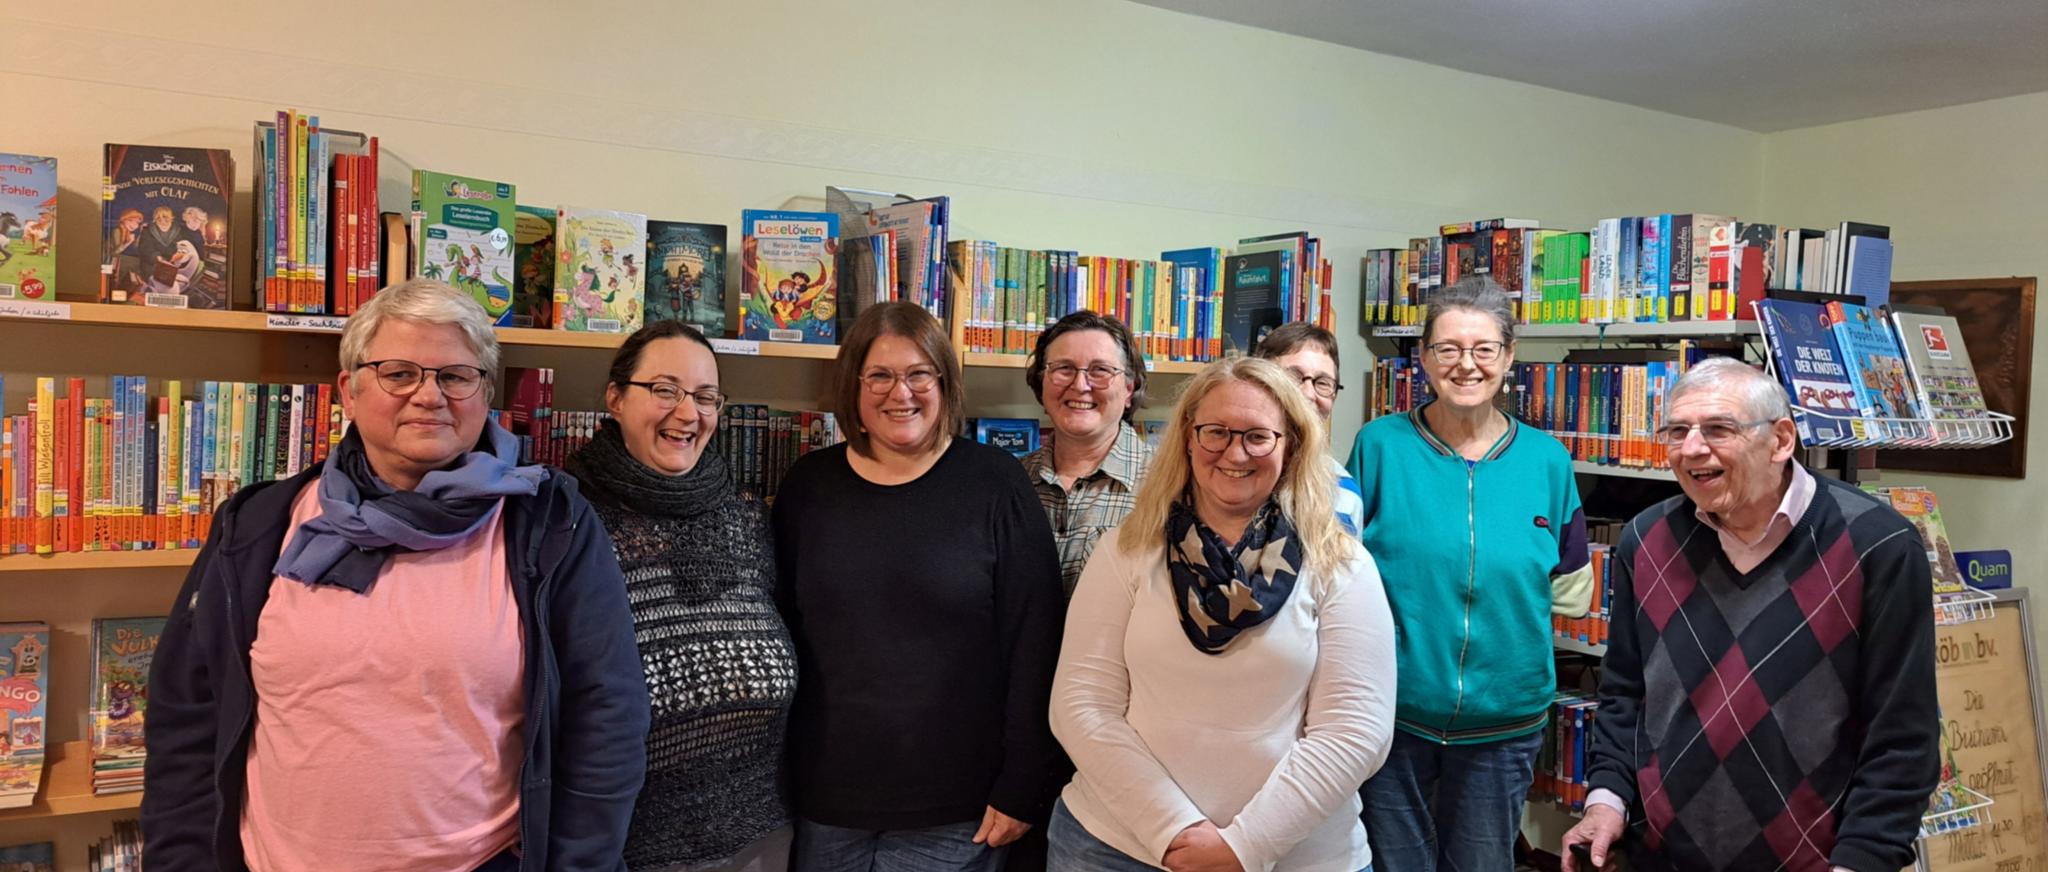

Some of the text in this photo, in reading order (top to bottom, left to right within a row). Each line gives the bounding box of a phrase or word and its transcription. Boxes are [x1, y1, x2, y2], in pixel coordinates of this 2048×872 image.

[143, 161, 194, 173] EISKÖNIGIN
[1, 184, 39, 197] Fohlen
[758, 223, 823, 236] Leselöwen
[308, 319, 344, 329] Sachbü
[1796, 346, 1833, 361] DIE WELT
[1795, 359, 1844, 376] DER KNOTEN
[992, 436, 1024, 448] Major Tom
[38, 472, 50, 485] Till
[1968, 560, 2008, 582] Quam
[116, 628, 144, 641] Die
[0, 687, 41, 703] NGO
[1963, 689, 1984, 711] Die
